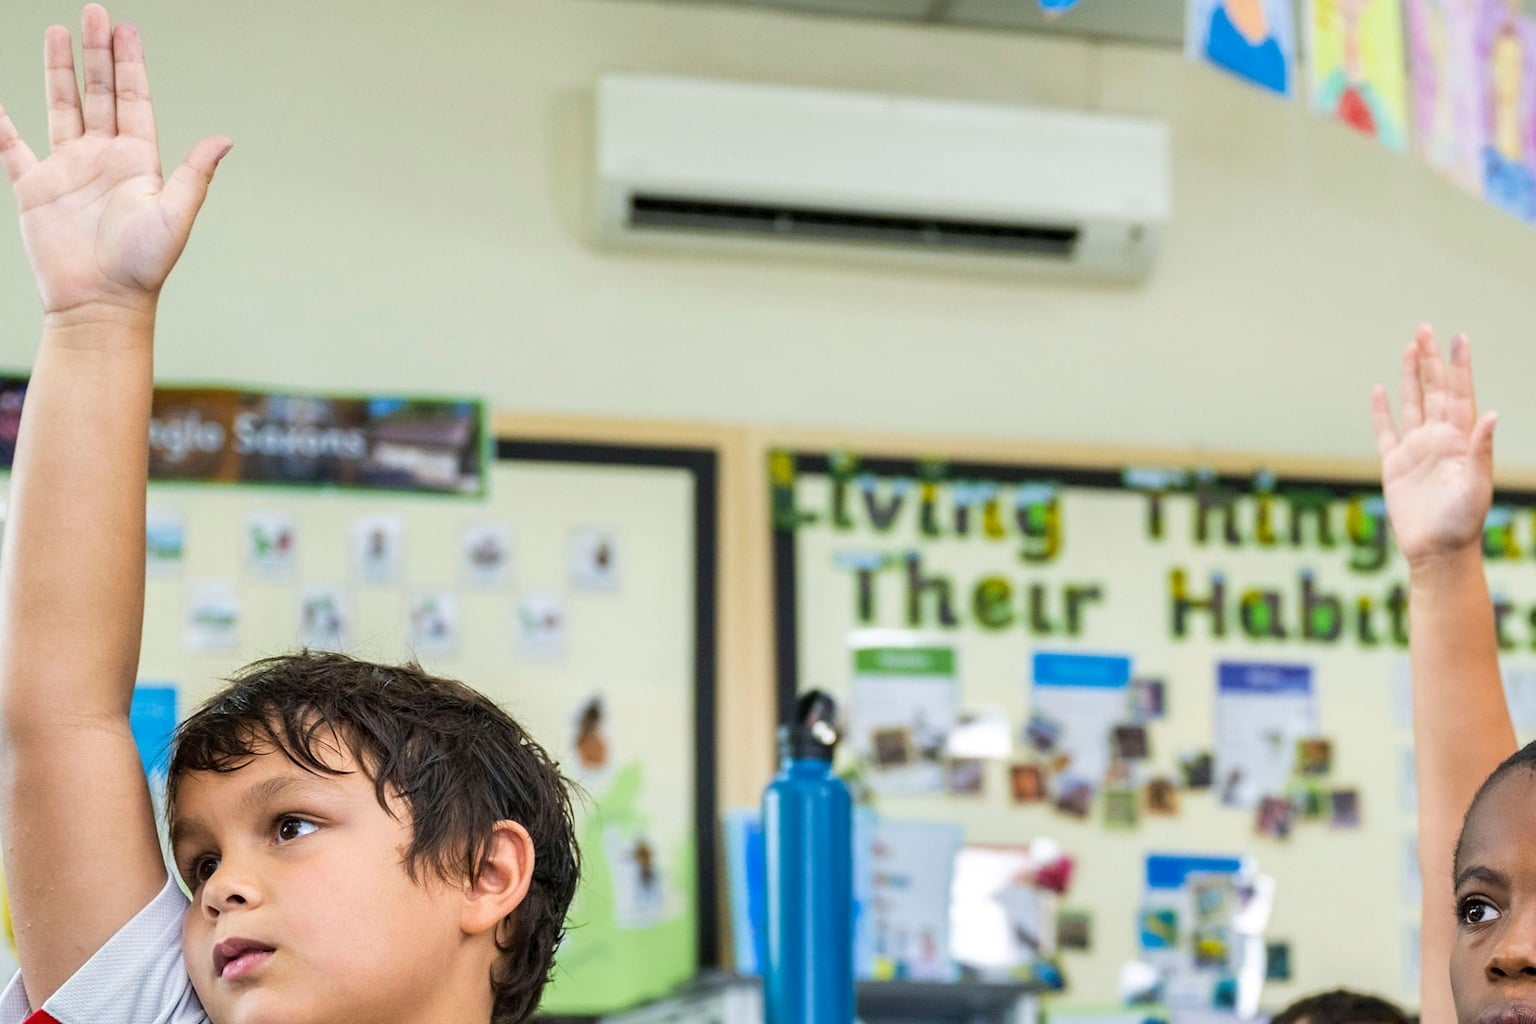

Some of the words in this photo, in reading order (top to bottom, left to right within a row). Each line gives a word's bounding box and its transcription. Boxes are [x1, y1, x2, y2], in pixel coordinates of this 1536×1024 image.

[149, 410, 225, 463] nglo
[769, 448, 1064, 562] Living
[1123, 468, 1390, 571] Thing
[833, 552, 1100, 636] Their
